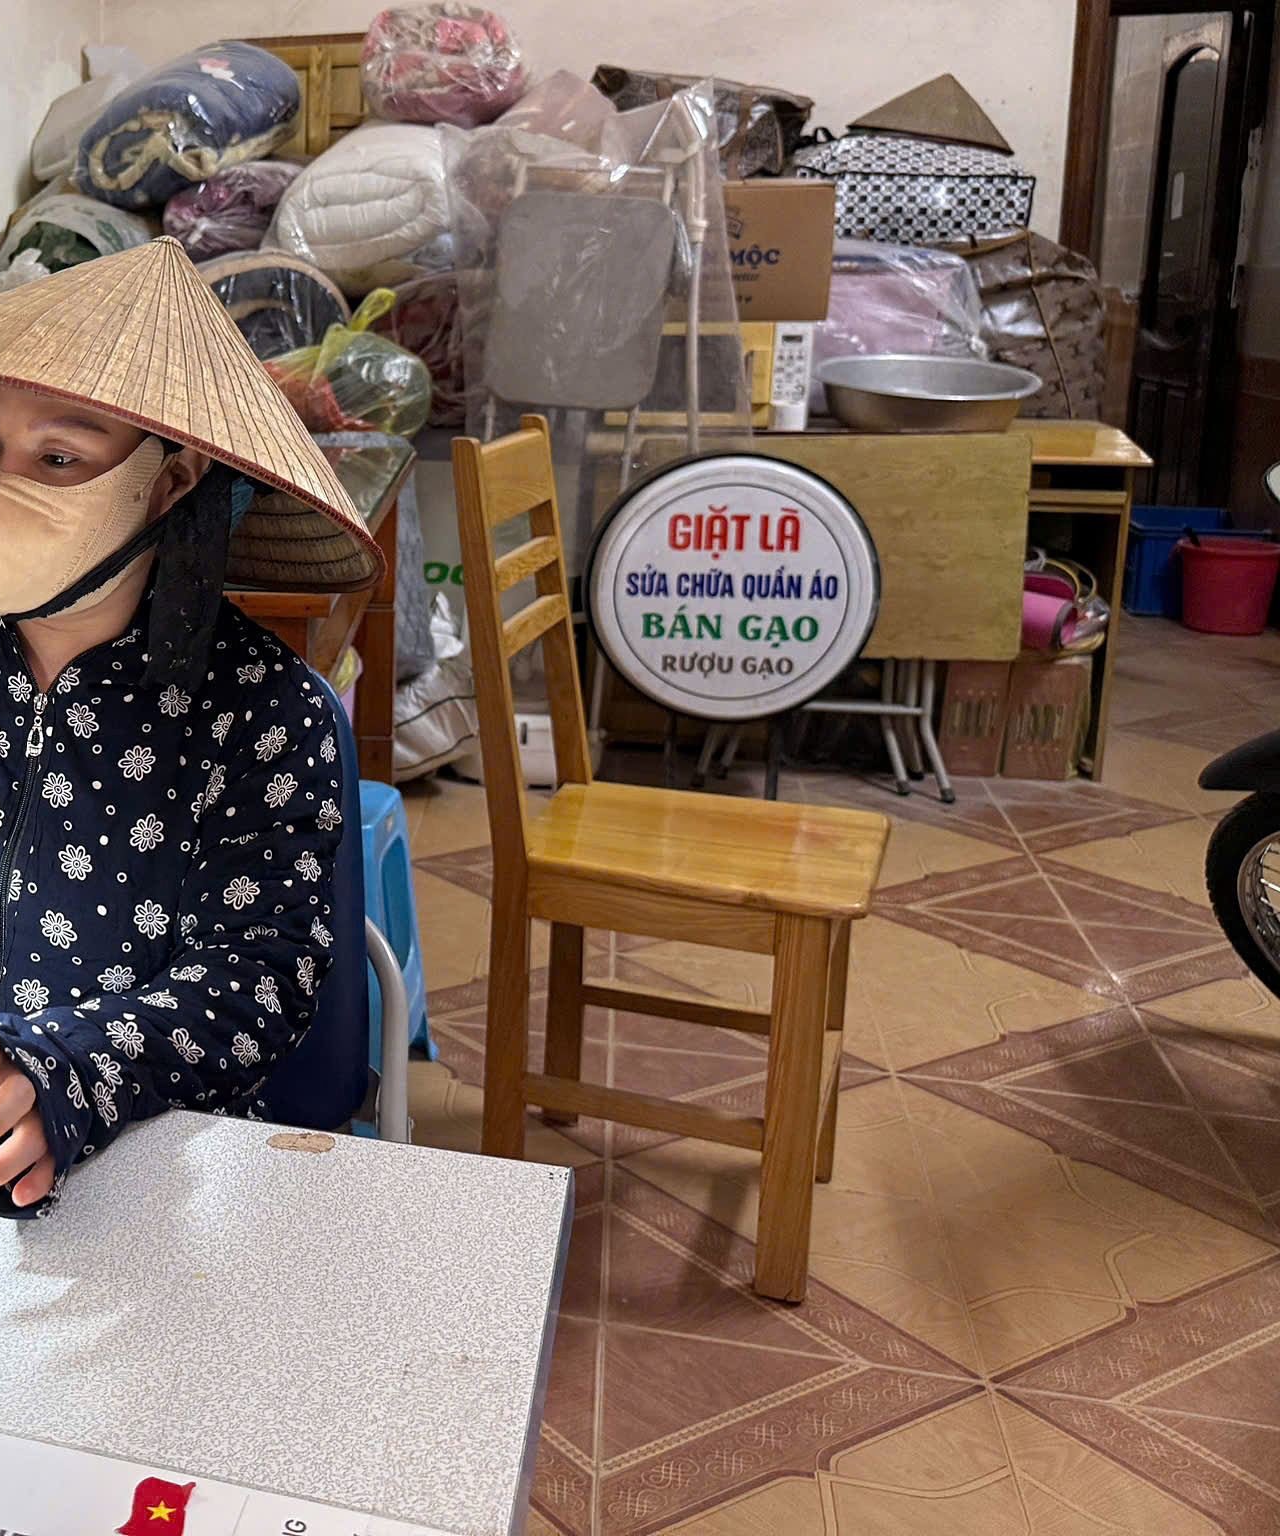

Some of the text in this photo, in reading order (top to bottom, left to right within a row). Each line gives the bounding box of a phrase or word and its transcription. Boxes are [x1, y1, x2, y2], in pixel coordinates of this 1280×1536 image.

[668, 505, 801, 560] GIẶT LÀ
[626, 564, 670, 597] SỬA
[676, 568, 734, 598] CHỮA
[808, 569, 839, 600] ÁO
[641, 604, 819, 648] BÁN GẠO
[662, 652, 793, 680] RƯỢU GẠO
